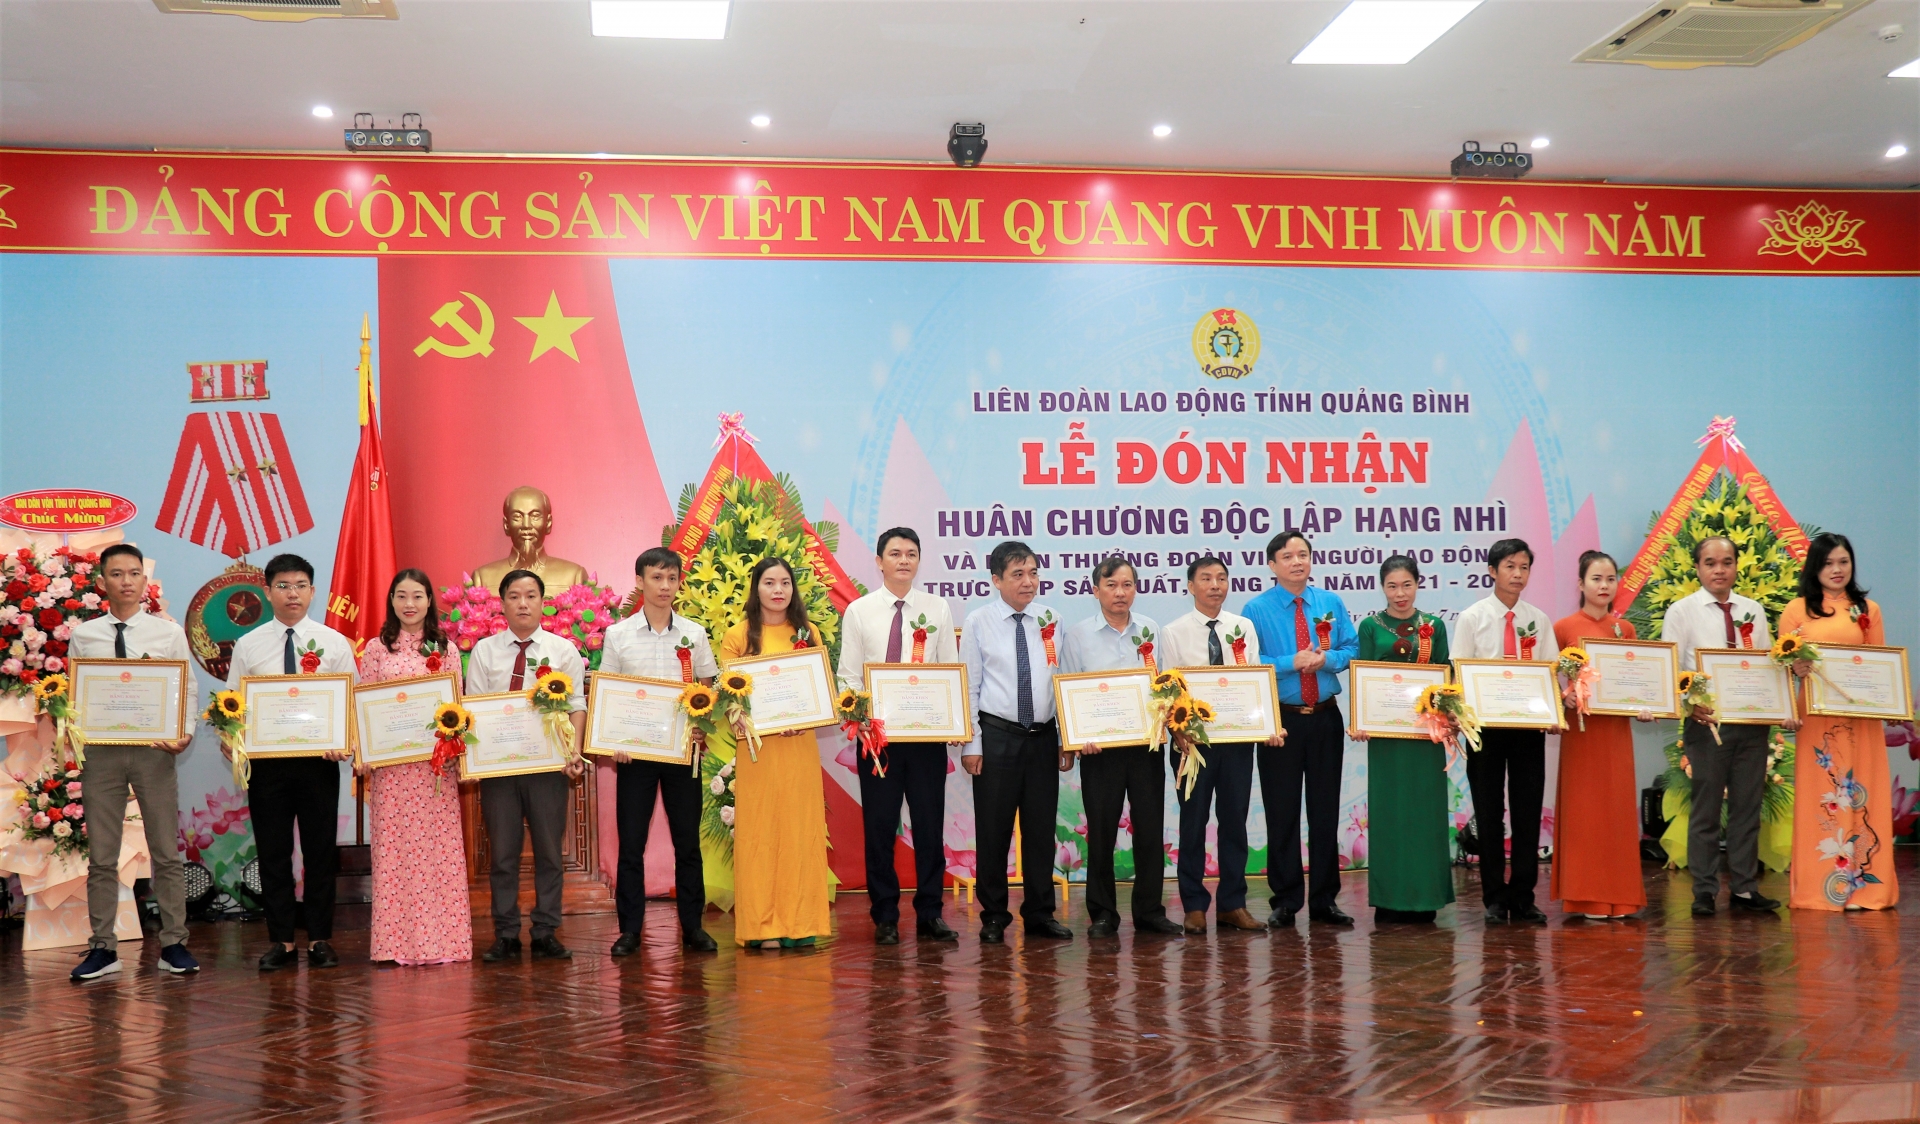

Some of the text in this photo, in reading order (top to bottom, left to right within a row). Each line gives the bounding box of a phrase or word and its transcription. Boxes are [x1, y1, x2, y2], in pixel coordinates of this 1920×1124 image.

[89, 165, 1706, 258] ĐẢNG CỘNG SẢN VIỆT NAM QUANG VINH MUÔN NĂM
[973, 387, 1470, 417] LIÊN ĐOÀN LAO ĐỘNG TỈNH QUẢNG BÌNH
[1022, 422, 1429, 494] LỄ ĐÓN NHẬN
[1693, 463, 1715, 486] NAM
[22, 511, 106, 526] Chúc Mừng
[938, 500, 1507, 540] HUÂN CHƯƠNG ĐỘC LẬP HẠNG NHÌ
[943, 551, 977, 570] VÀ
[1312, 546, 1382, 565] NGƯỜI
[1442, 545, 1488, 566] ĐỘN
[923, 579, 991, 600] TRỰC
[1136, 573, 1188, 596] UẤT,
[1324, 573, 1375, 591] NĂM
[327, 592, 360, 623] LIÊN
